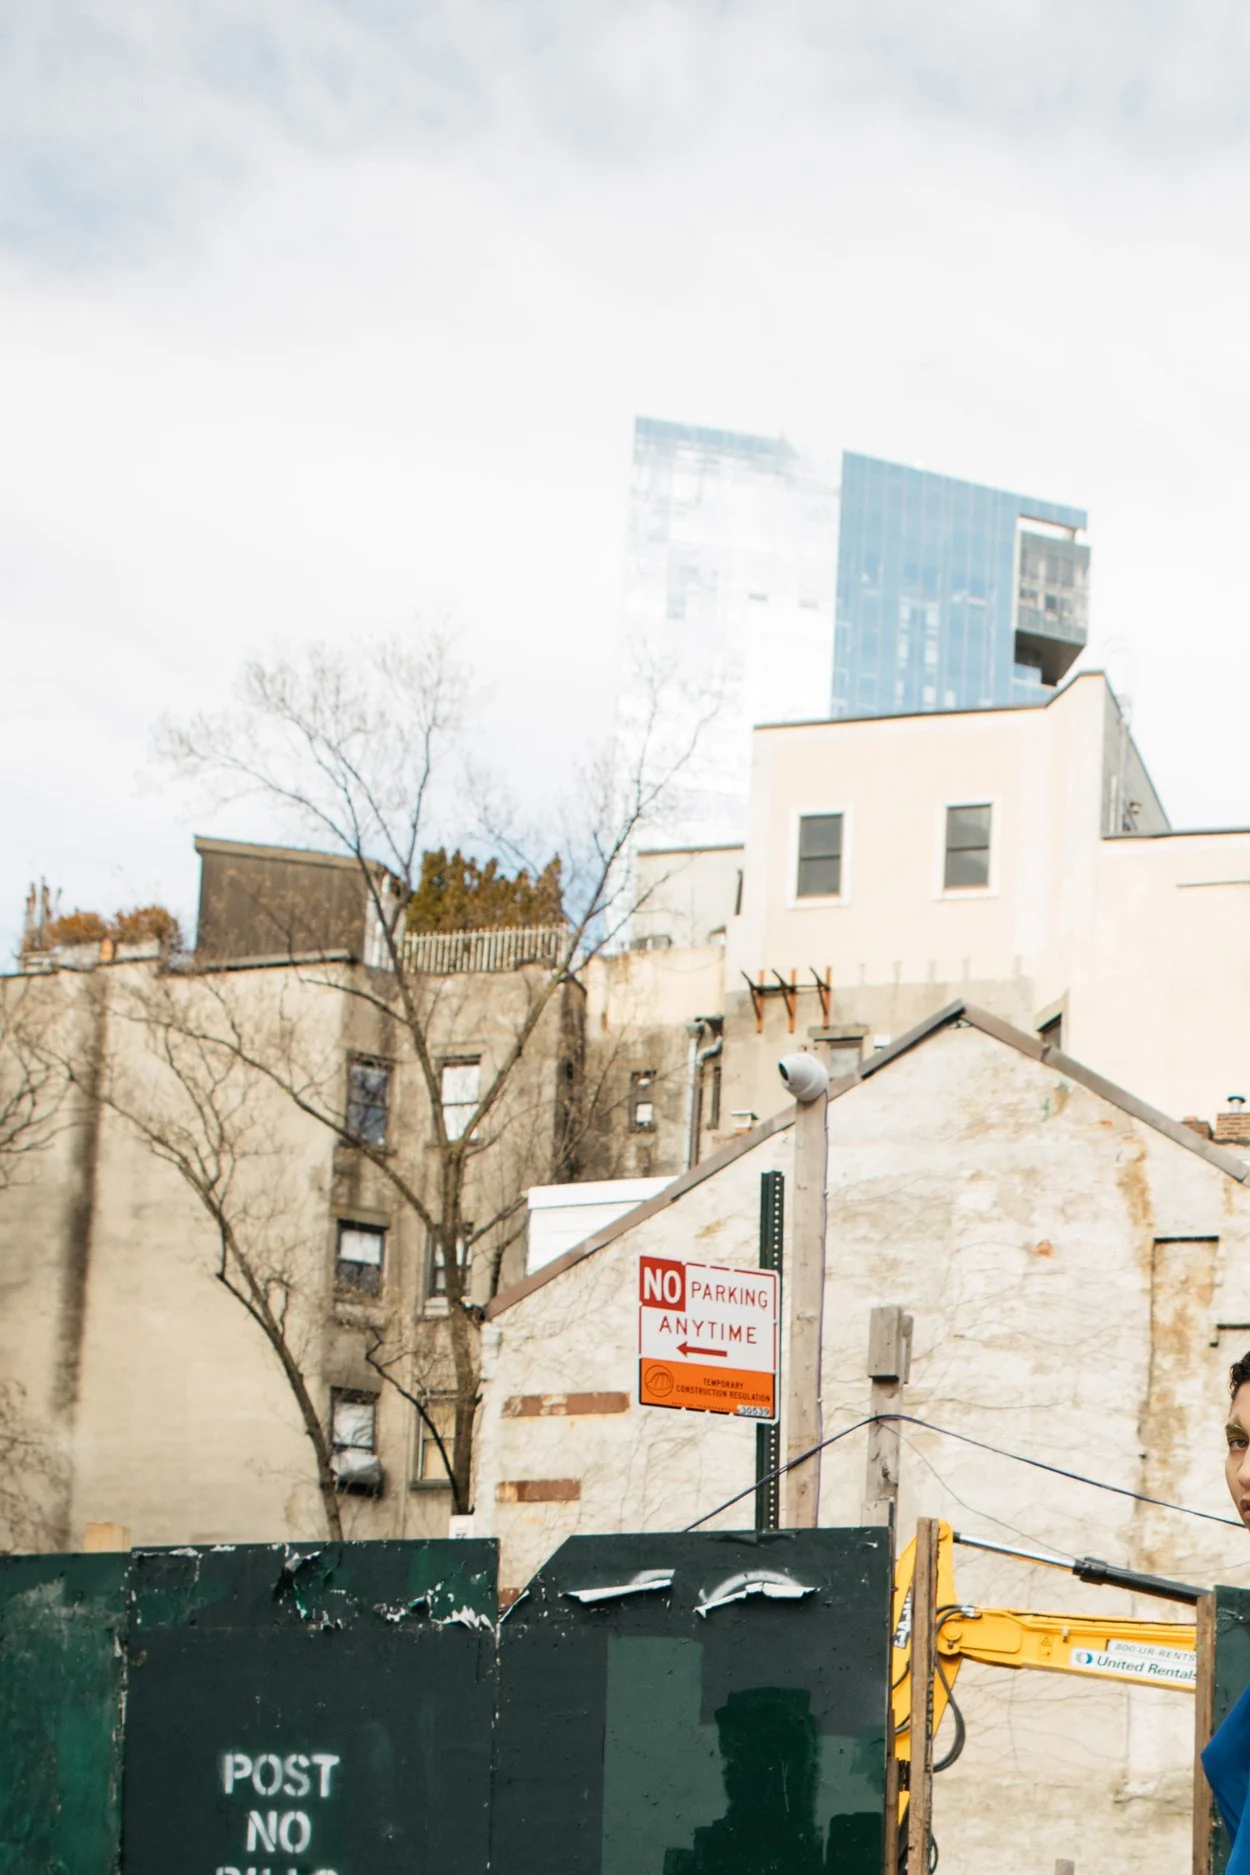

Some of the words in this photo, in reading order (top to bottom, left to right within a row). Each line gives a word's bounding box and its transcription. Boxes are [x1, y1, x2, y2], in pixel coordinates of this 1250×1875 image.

[643, 1266, 682, 1304] NO
[691, 1281, 768, 1309] PARKING
[659, 1315, 757, 1345] ANYTIME
[676, 1384, 727, 1397] CONSTRUCTION
[729, 1391, 771, 1402] REGULATION
[703, 1377, 744, 1390] TEMPORARY
[741, 1406, 770, 1416] 30539
[1097, 1655, 1145, 1673] United
[224, 1754, 340, 1798] POST
[246, 1810, 312, 1854] NO
